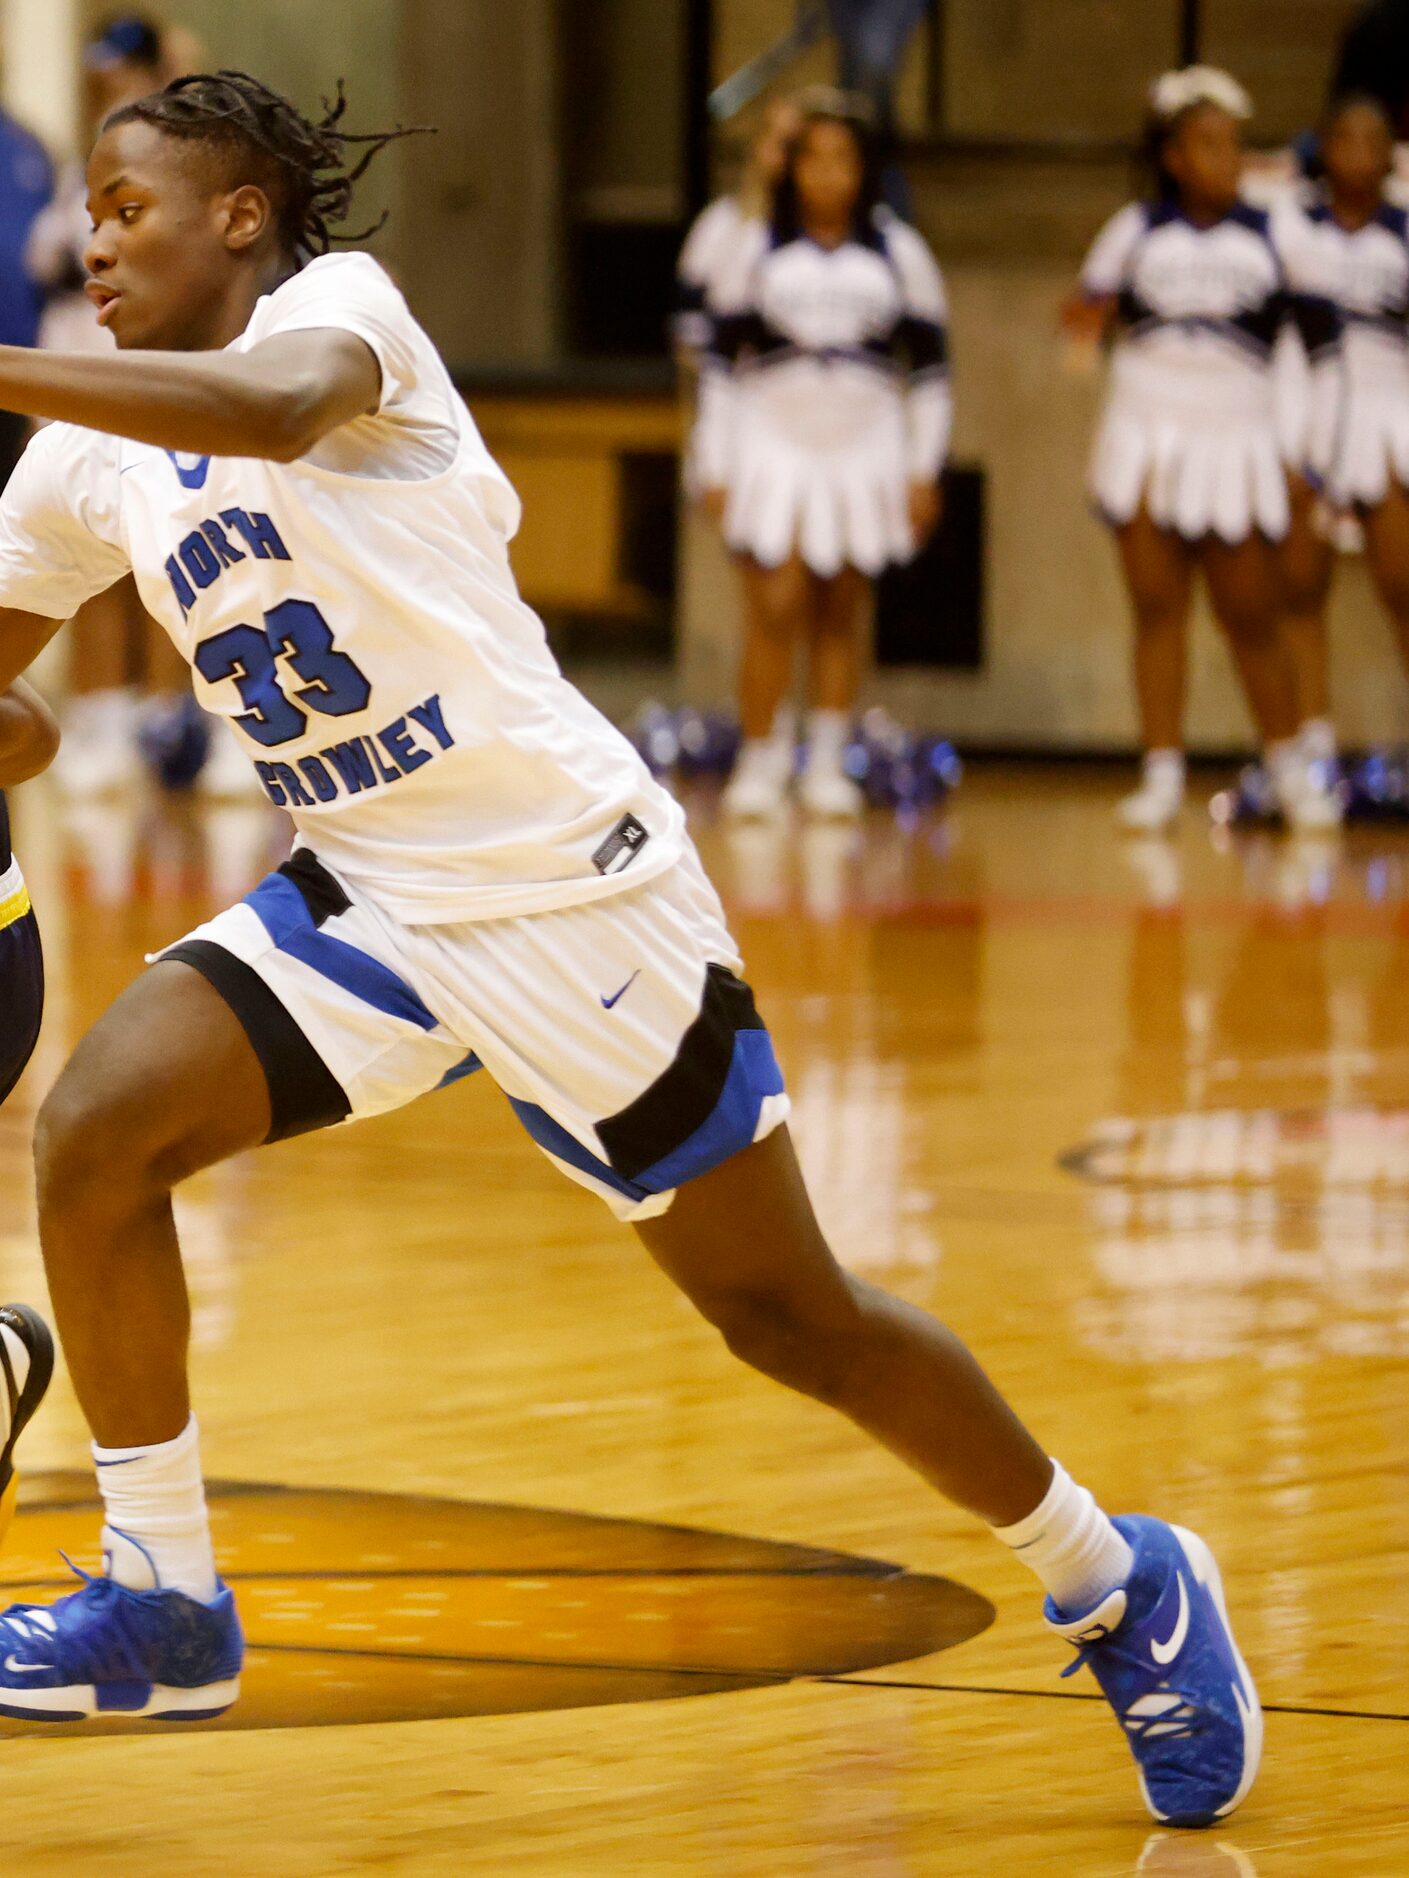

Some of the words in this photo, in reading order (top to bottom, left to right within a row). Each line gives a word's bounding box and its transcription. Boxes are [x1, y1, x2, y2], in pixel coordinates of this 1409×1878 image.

[164, 506, 294, 626] NORTH
[194, 597, 372, 747] 33
[253, 693, 455, 806] CROWLEY
[622, 826, 642, 843] XL
